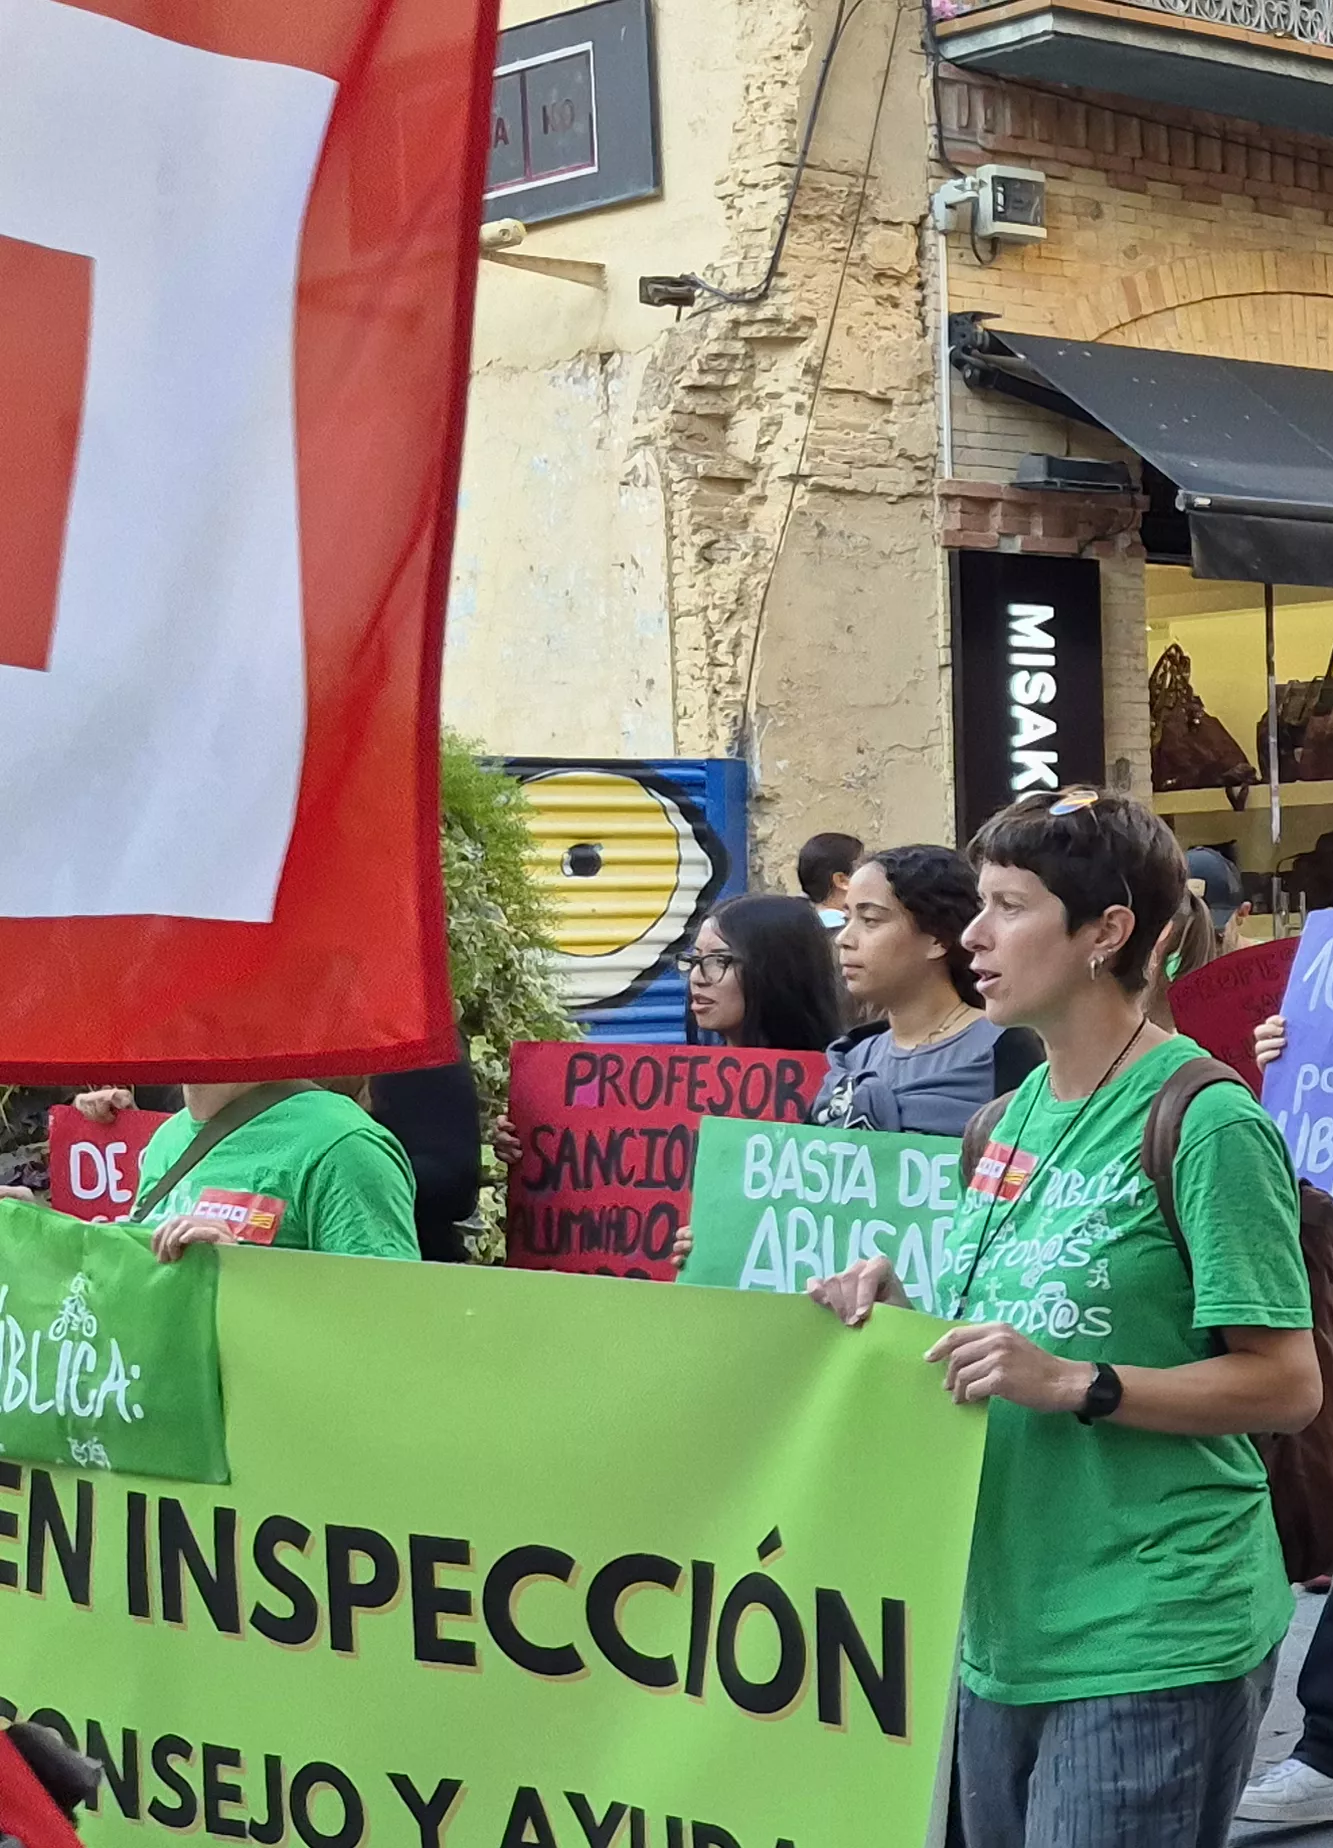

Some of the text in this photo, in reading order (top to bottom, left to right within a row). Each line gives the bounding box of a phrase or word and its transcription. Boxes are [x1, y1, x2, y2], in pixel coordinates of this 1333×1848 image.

[1008, 603, 1060, 801] MISAK
[564, 1051, 810, 1121] PROFESOR
[70, 1141, 132, 1203] DE
[743, 1133, 878, 1208] BASTA
[898, 1148, 959, 1210] DE
[0, 1286, 144, 1424] BLICA:
[127, 1490, 908, 1738] INSPECCIÓN
[386, 1772, 464, 1848] Y
